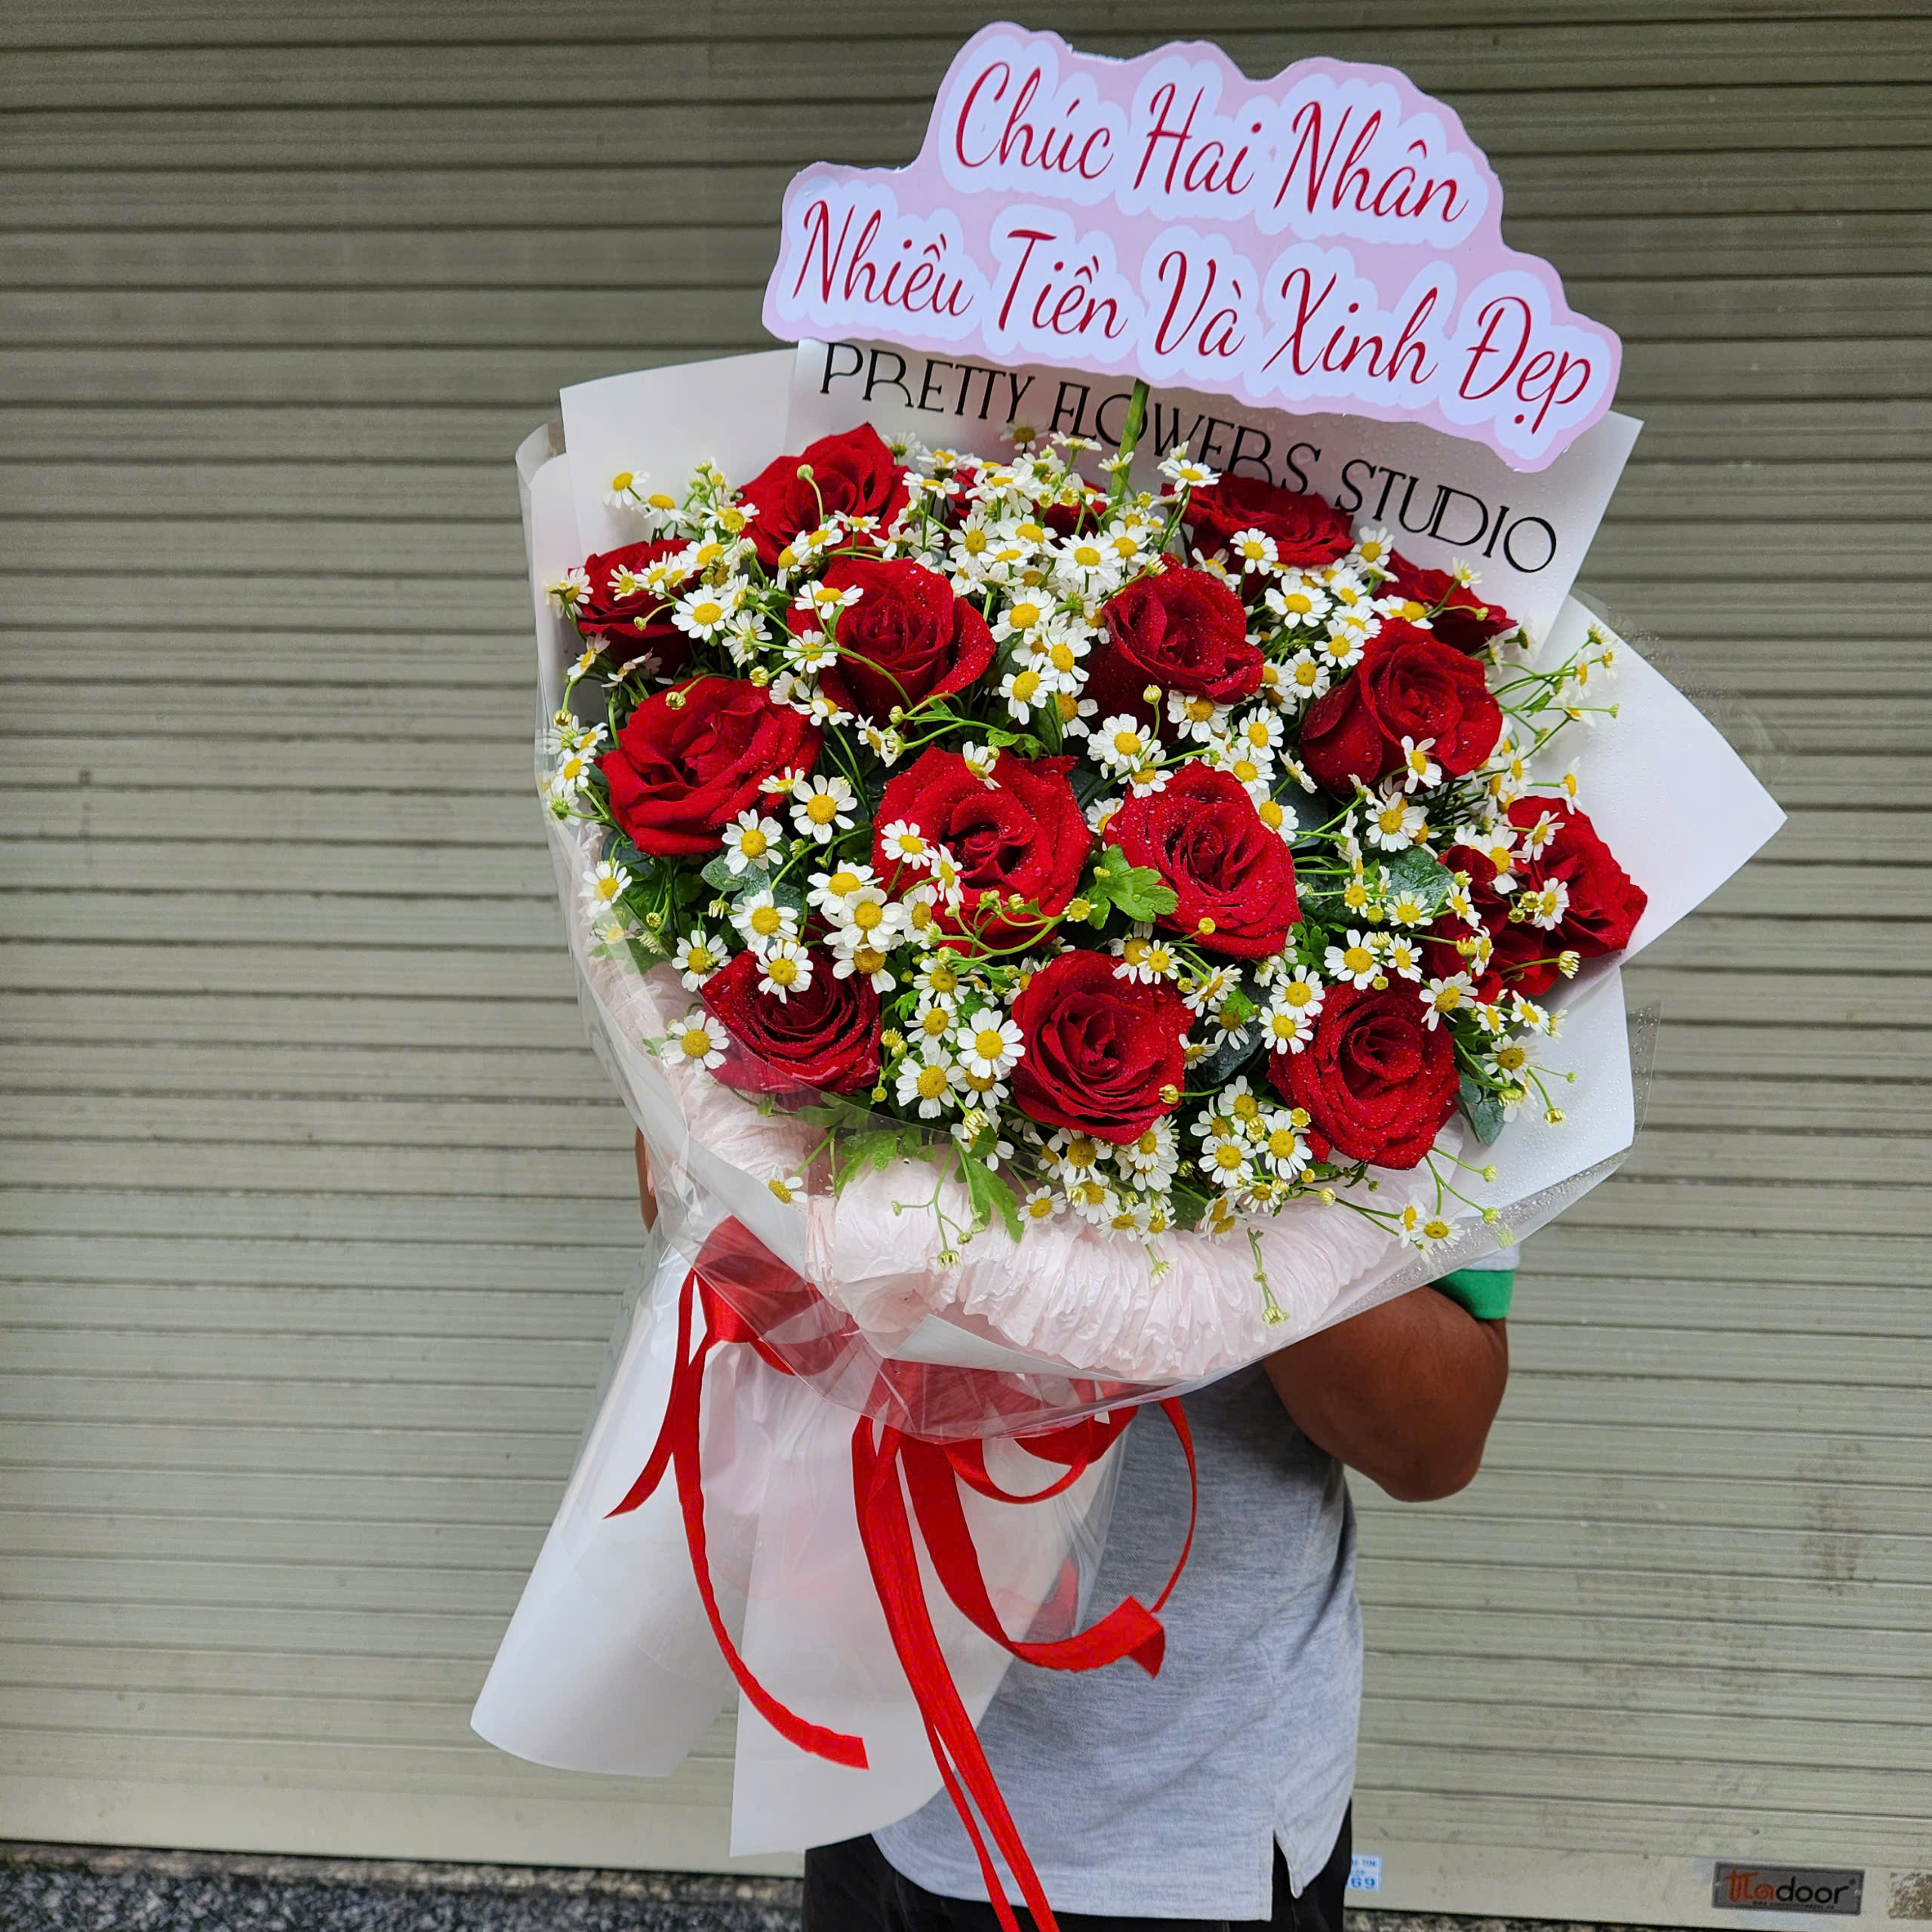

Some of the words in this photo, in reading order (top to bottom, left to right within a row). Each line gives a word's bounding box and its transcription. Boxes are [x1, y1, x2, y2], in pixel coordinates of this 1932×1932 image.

[955, 61, 1114, 180] Chúc
[1133, 82, 1262, 196] Hai
[1273, 100, 1469, 223] Nhân
[792, 199, 974, 317] Nhiều
[997, 228, 1128, 339] Tiền
[1154, 250, 1246, 358] Và
[1261, 266, 1438, 384] Xinh
[1457, 295, 1592, 435] Đẹp
[819, 341, 1035, 424] PRETTY
[1048, 381, 1321, 494] FLOWERS
[1334, 458, 1557, 574] STUDIO
[1345, 1877, 1375, 1889] 69
